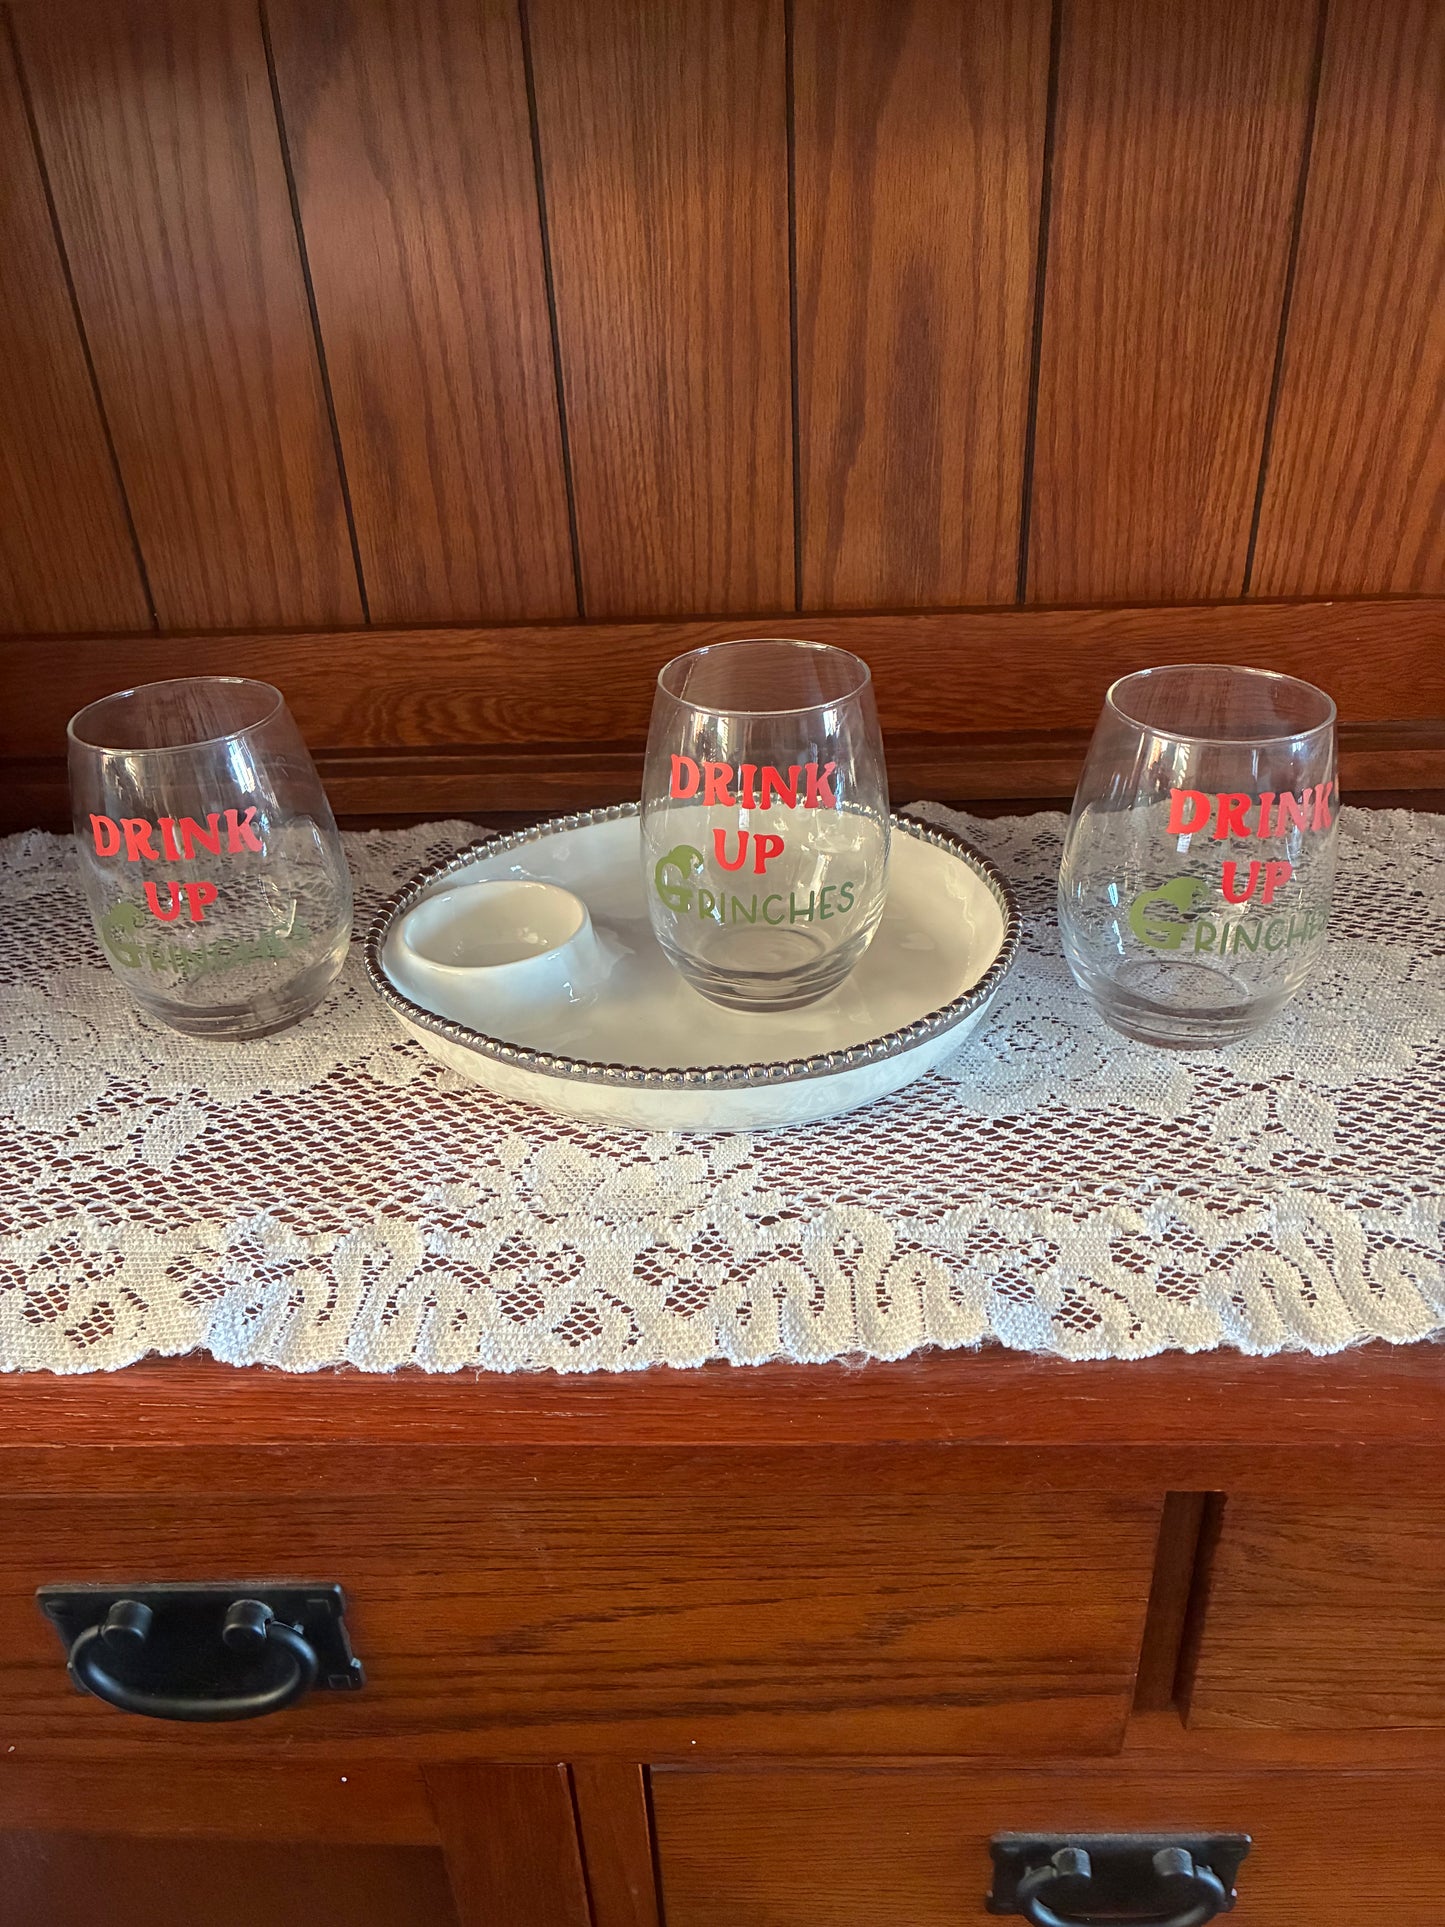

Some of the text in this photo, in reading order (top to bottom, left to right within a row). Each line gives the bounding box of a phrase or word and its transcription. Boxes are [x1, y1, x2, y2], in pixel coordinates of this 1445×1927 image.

[671, 754, 836, 810] DRINK
[90, 807, 262, 861] DRINK
[1166, 782, 1333, 840] DRINK
[713, 829, 785, 874] UP
[143, 881, 218, 921] UP
[655, 845, 855, 925] GRINCHES
[1222, 861, 1292, 904] UP
